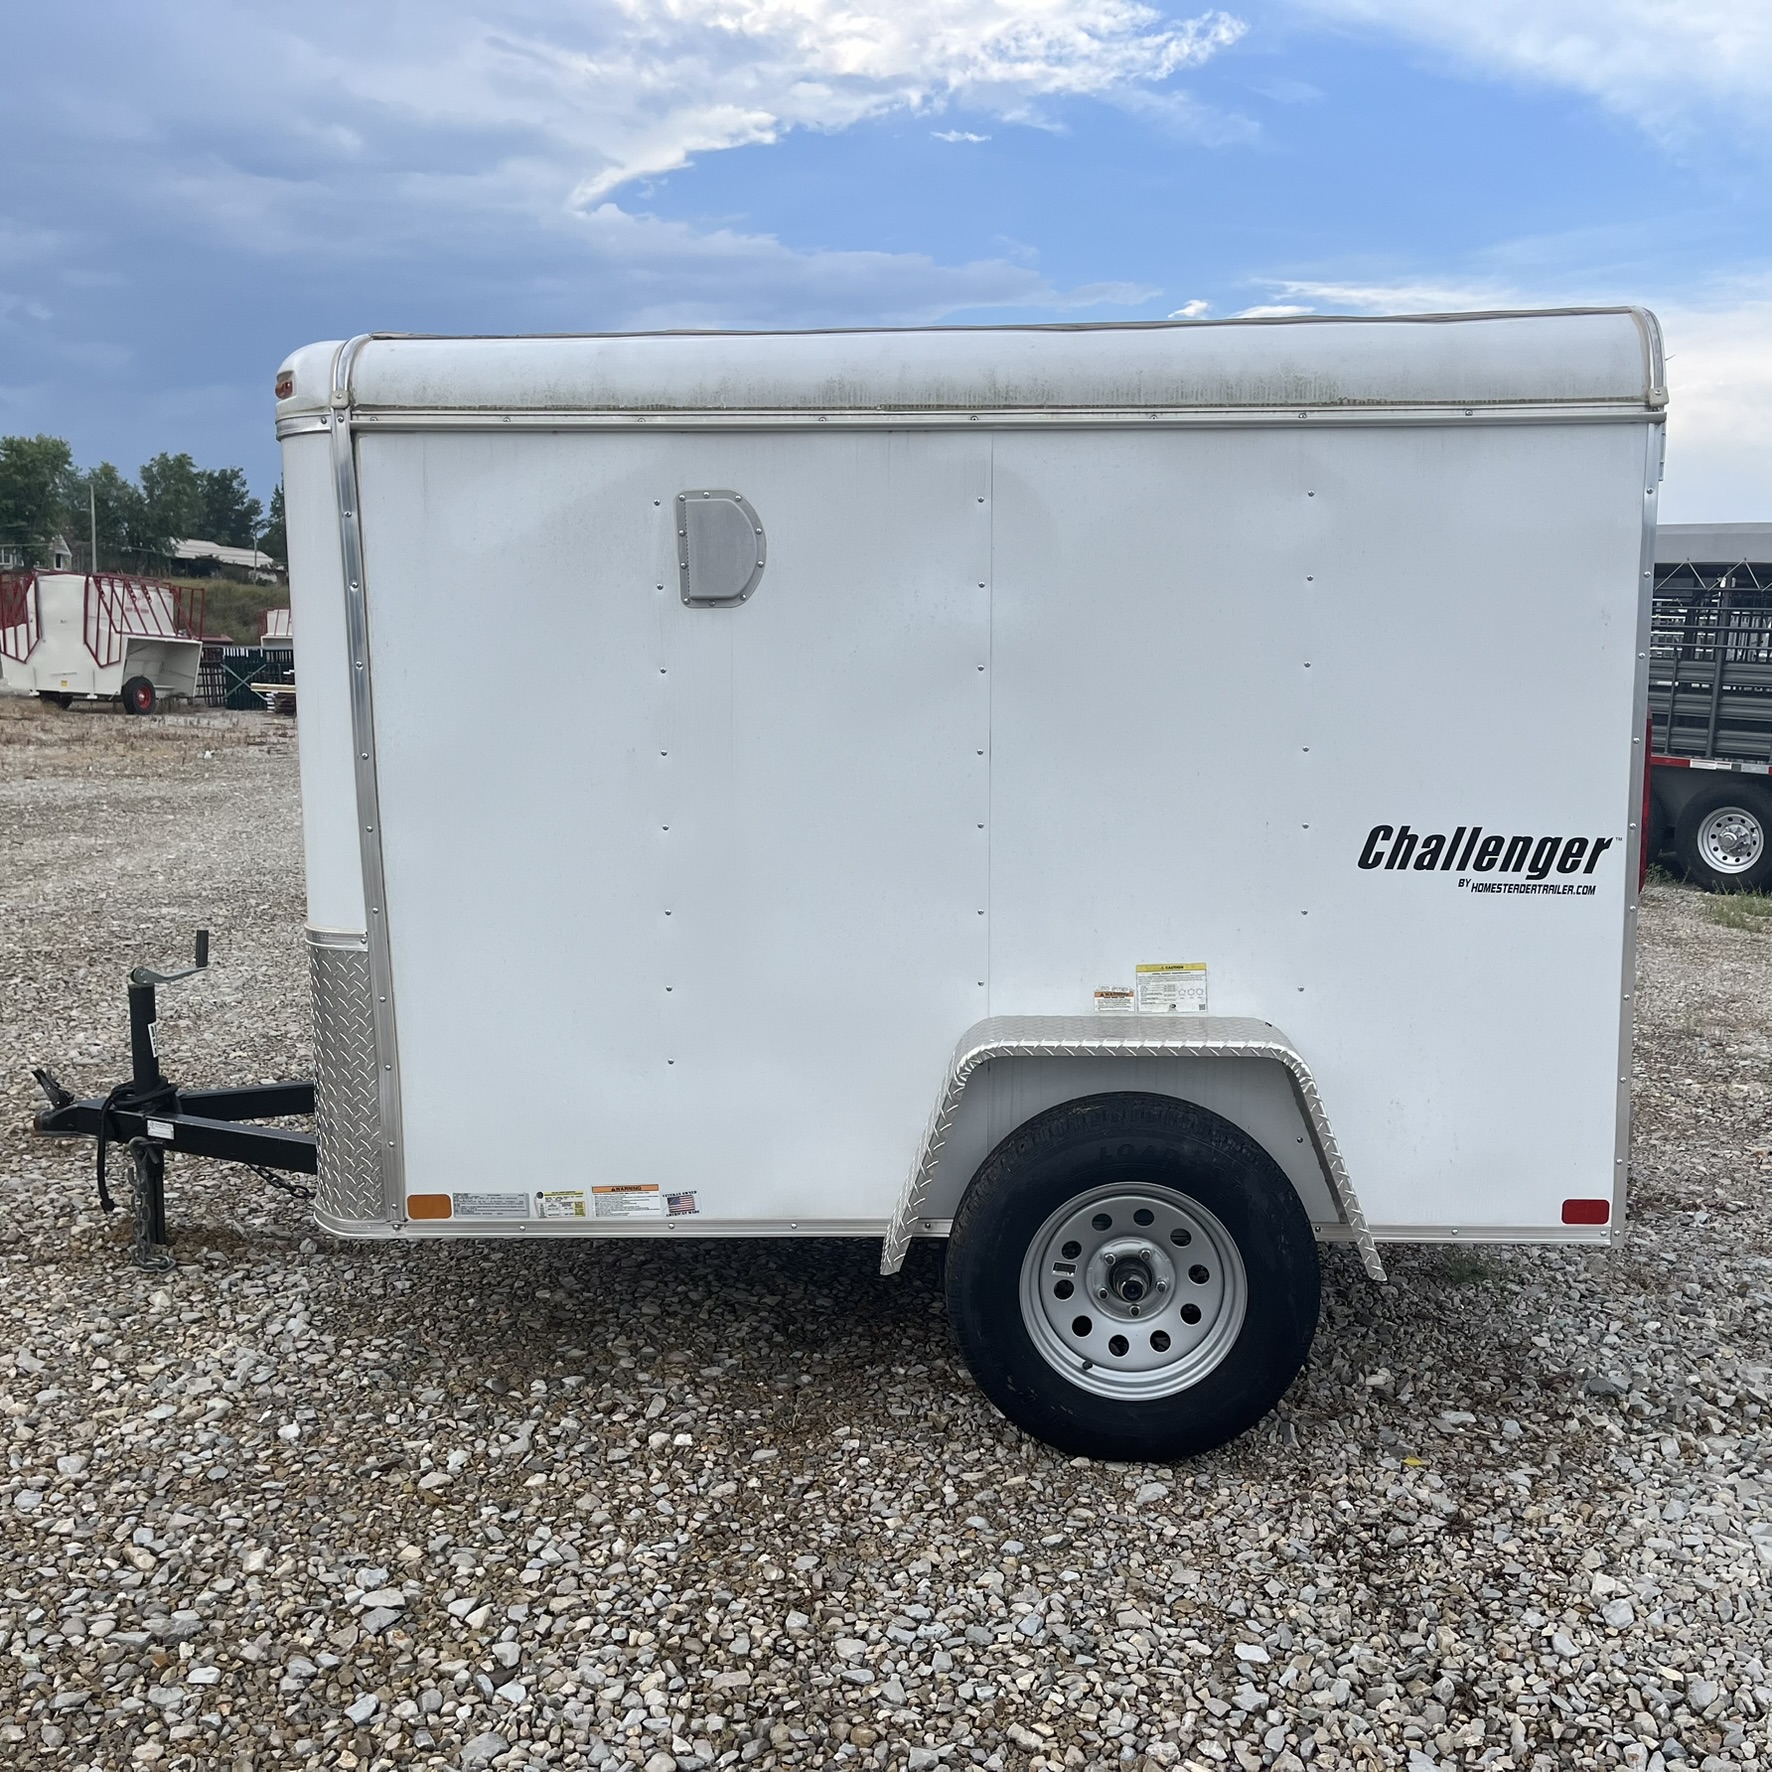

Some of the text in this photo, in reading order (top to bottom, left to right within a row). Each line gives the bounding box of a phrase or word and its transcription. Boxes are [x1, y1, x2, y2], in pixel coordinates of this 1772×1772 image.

[1357, 825, 1614, 881] Challenger
[1458, 878, 1597, 896] BY HOMESTEADERTRAILER.COM
